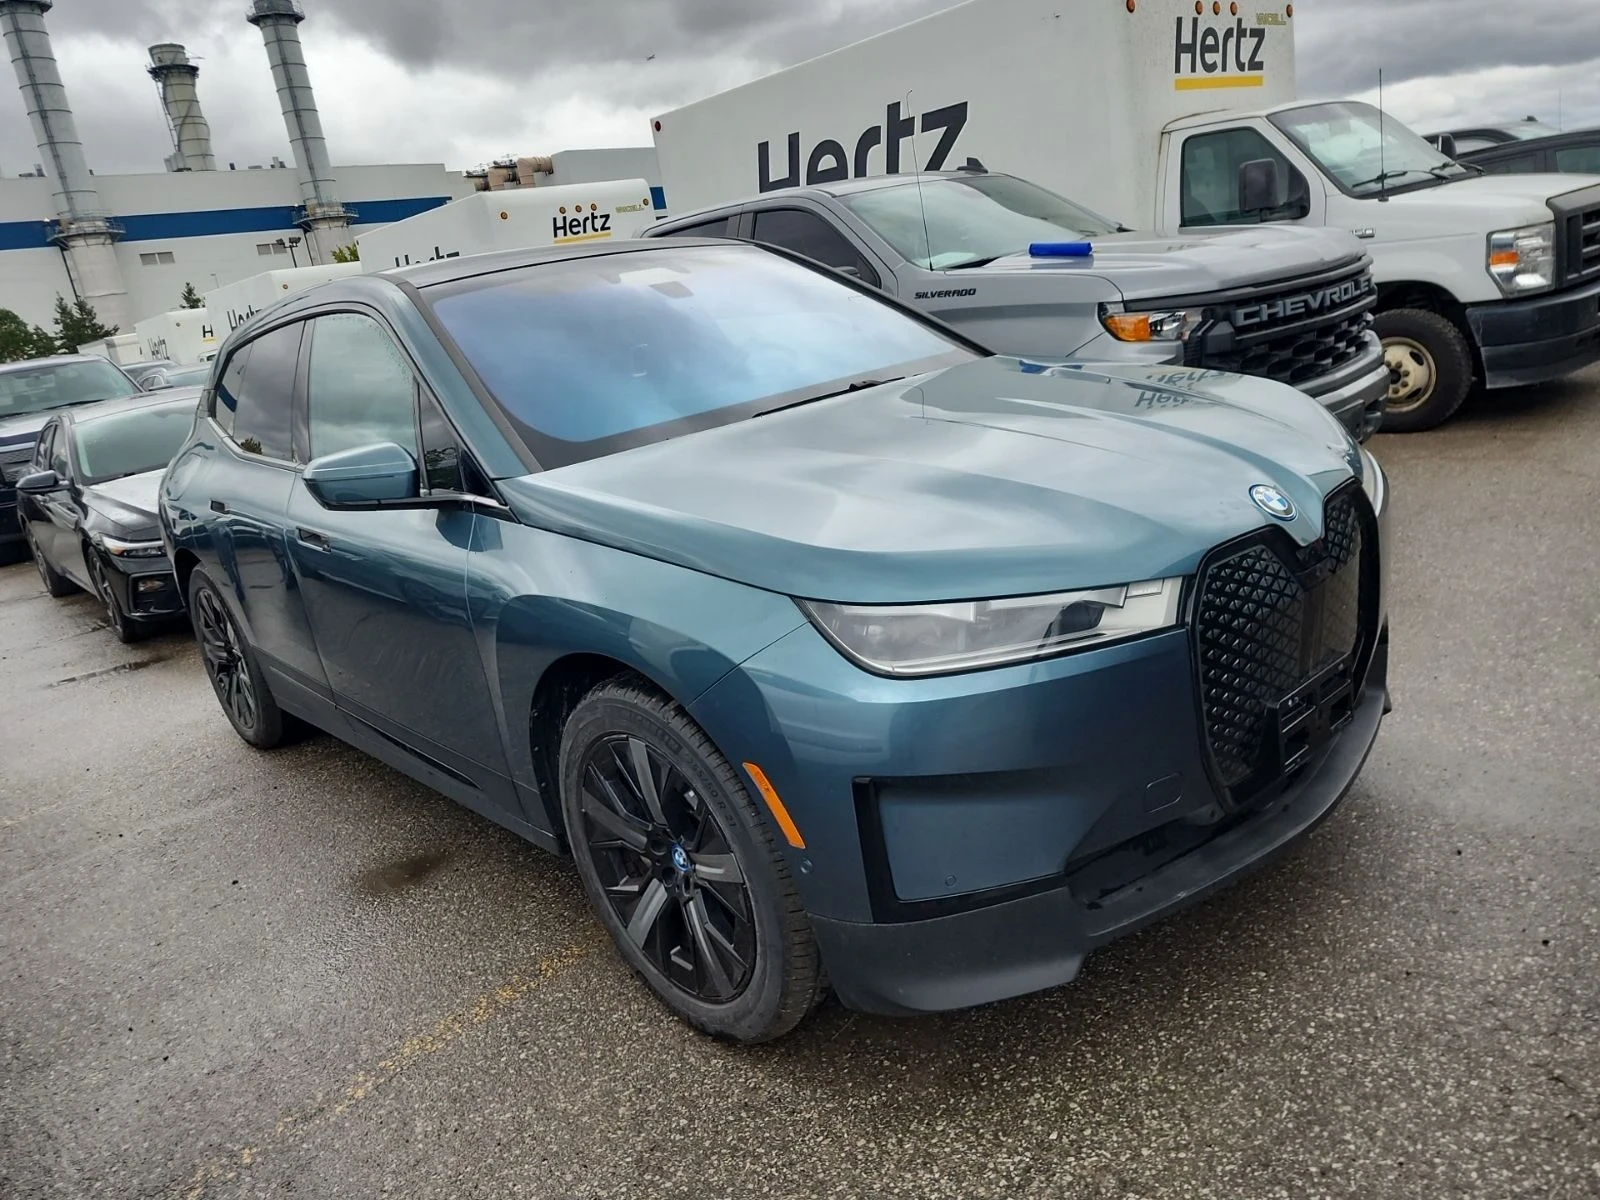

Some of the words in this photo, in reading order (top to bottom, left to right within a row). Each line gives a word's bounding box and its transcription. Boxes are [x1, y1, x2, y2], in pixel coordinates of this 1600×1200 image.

[1175, 16, 1266, 74] Hertz
[757, 101, 968, 193] Hertz
[553, 212, 611, 238] Hertz
[914, 288, 977, 300] SILVERADO
